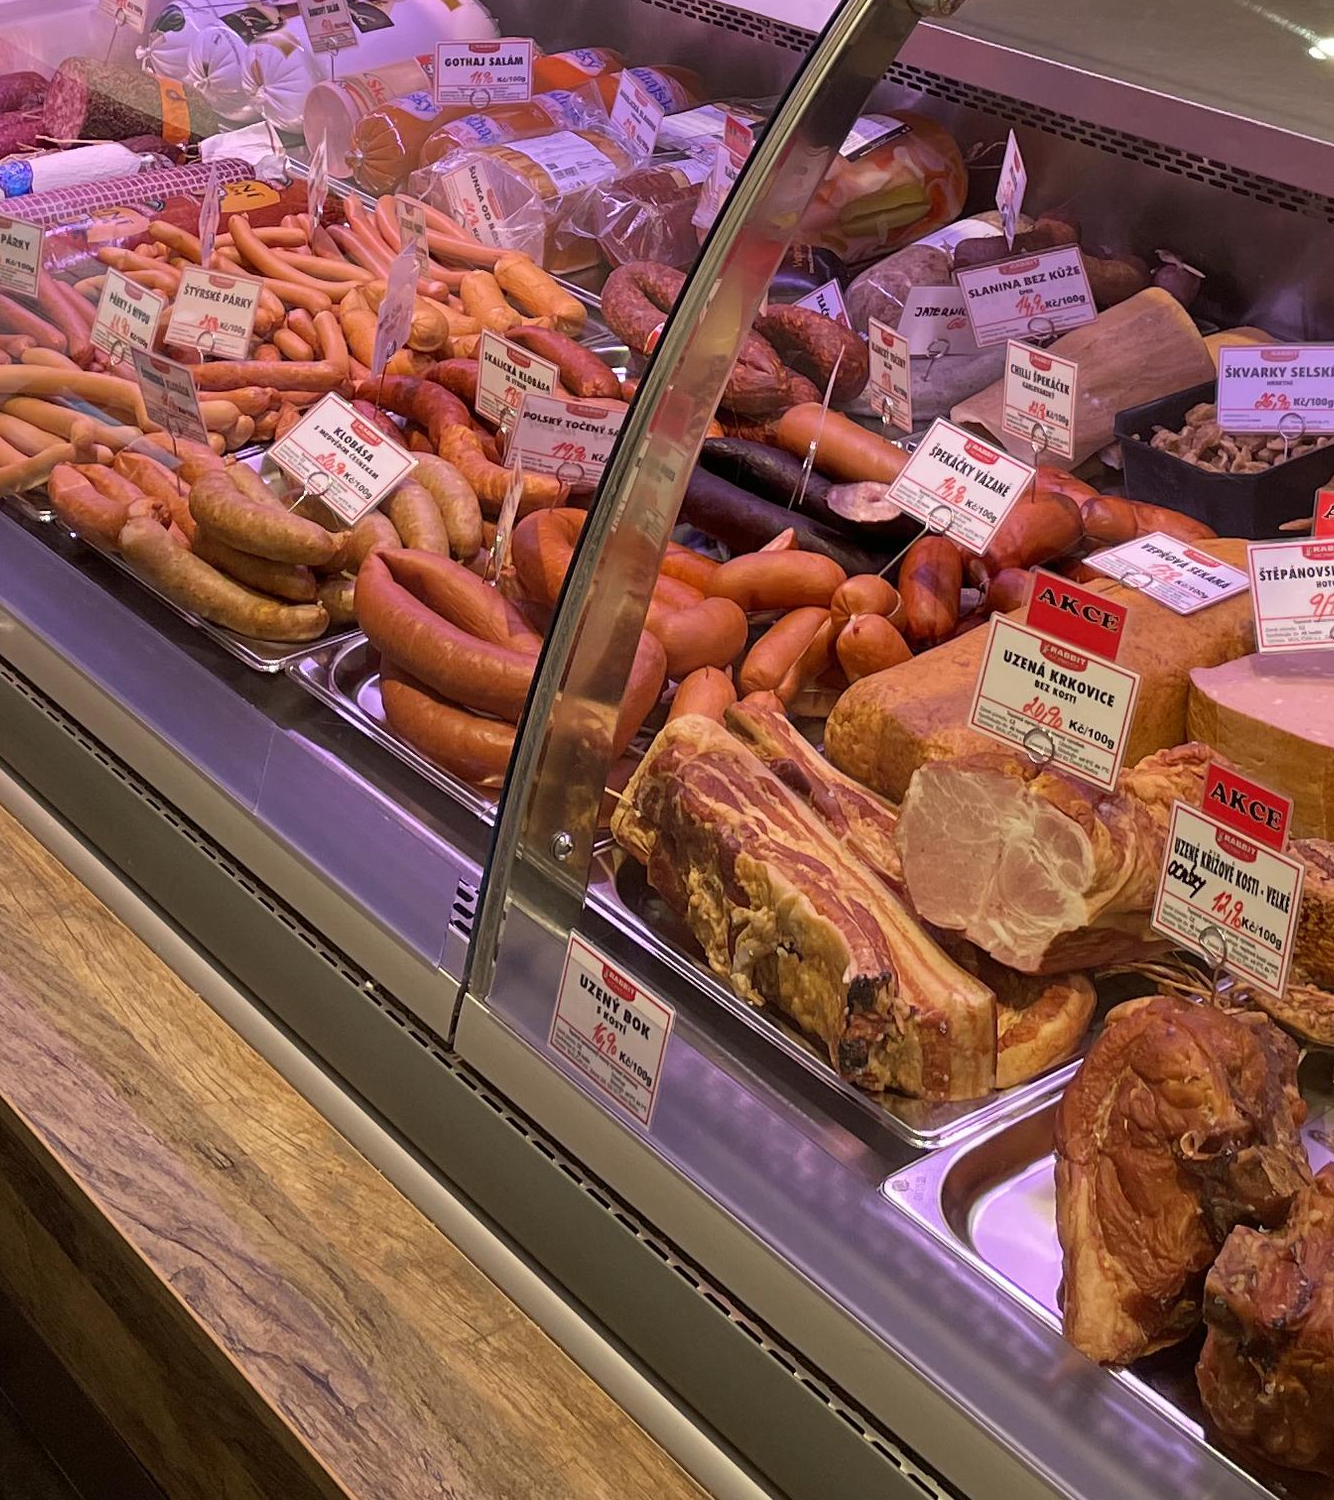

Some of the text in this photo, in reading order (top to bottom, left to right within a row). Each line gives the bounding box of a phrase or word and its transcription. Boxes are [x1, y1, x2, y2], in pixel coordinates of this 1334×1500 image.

[444, 54, 524, 67] GOTHAJ SALÁM
[1, 233, 30, 251] PÁRKY
[183, 283, 253, 310] ŠTÝRSKÉ PÁRKY
[968, 265, 1081, 299] SLANINA BEZ KŮŽE
[1044, 294, 1086, 309] Kč/100g
[484, 351, 550, 392] SKALICKÁ KLOBÁSA
[1033, 370, 1070, 396] ŠPEKÁČEK
[1225, 363, 1286, 379] ŠKVARKY
[1293, 397, 1334, 409] Kč/100g
[523, 411, 563, 426] POLSKÝ
[565, 417, 606, 434] TOČENÝ
[333, 426, 375, 463] KLOBÁSA
[349, 452, 380, 480] ČESNEKEM
[928, 443, 1012, 497] ŠPEKÁČKY VÁZANÉ
[965, 499, 997, 524] Kč/100g
[1142, 542, 1233, 590] VEPŘOVÁ SEKANÁ
[1038, 587, 1120, 632] AKCE
[1003, 649, 1115, 708] UZENÁ KRKOVICE
[1034, 679, 1077, 705] BEZ KOSTI
[1068, 719, 1115, 750] Kč/100g
[1210, 782, 1283, 832] AKCE
[1225, 836, 1257, 858] RABBIT
[1174, 835, 1292, 914] UZENÉ KŘÍŽOVÉ KOSTI VELKÉ
[1241, 917, 1283, 950] Kč/100g
[580, 973, 651, 1040] UZENÝ BOK
[596, 1005, 601, 1015] S
[619, 1051, 652, 1087] Kč/100g
